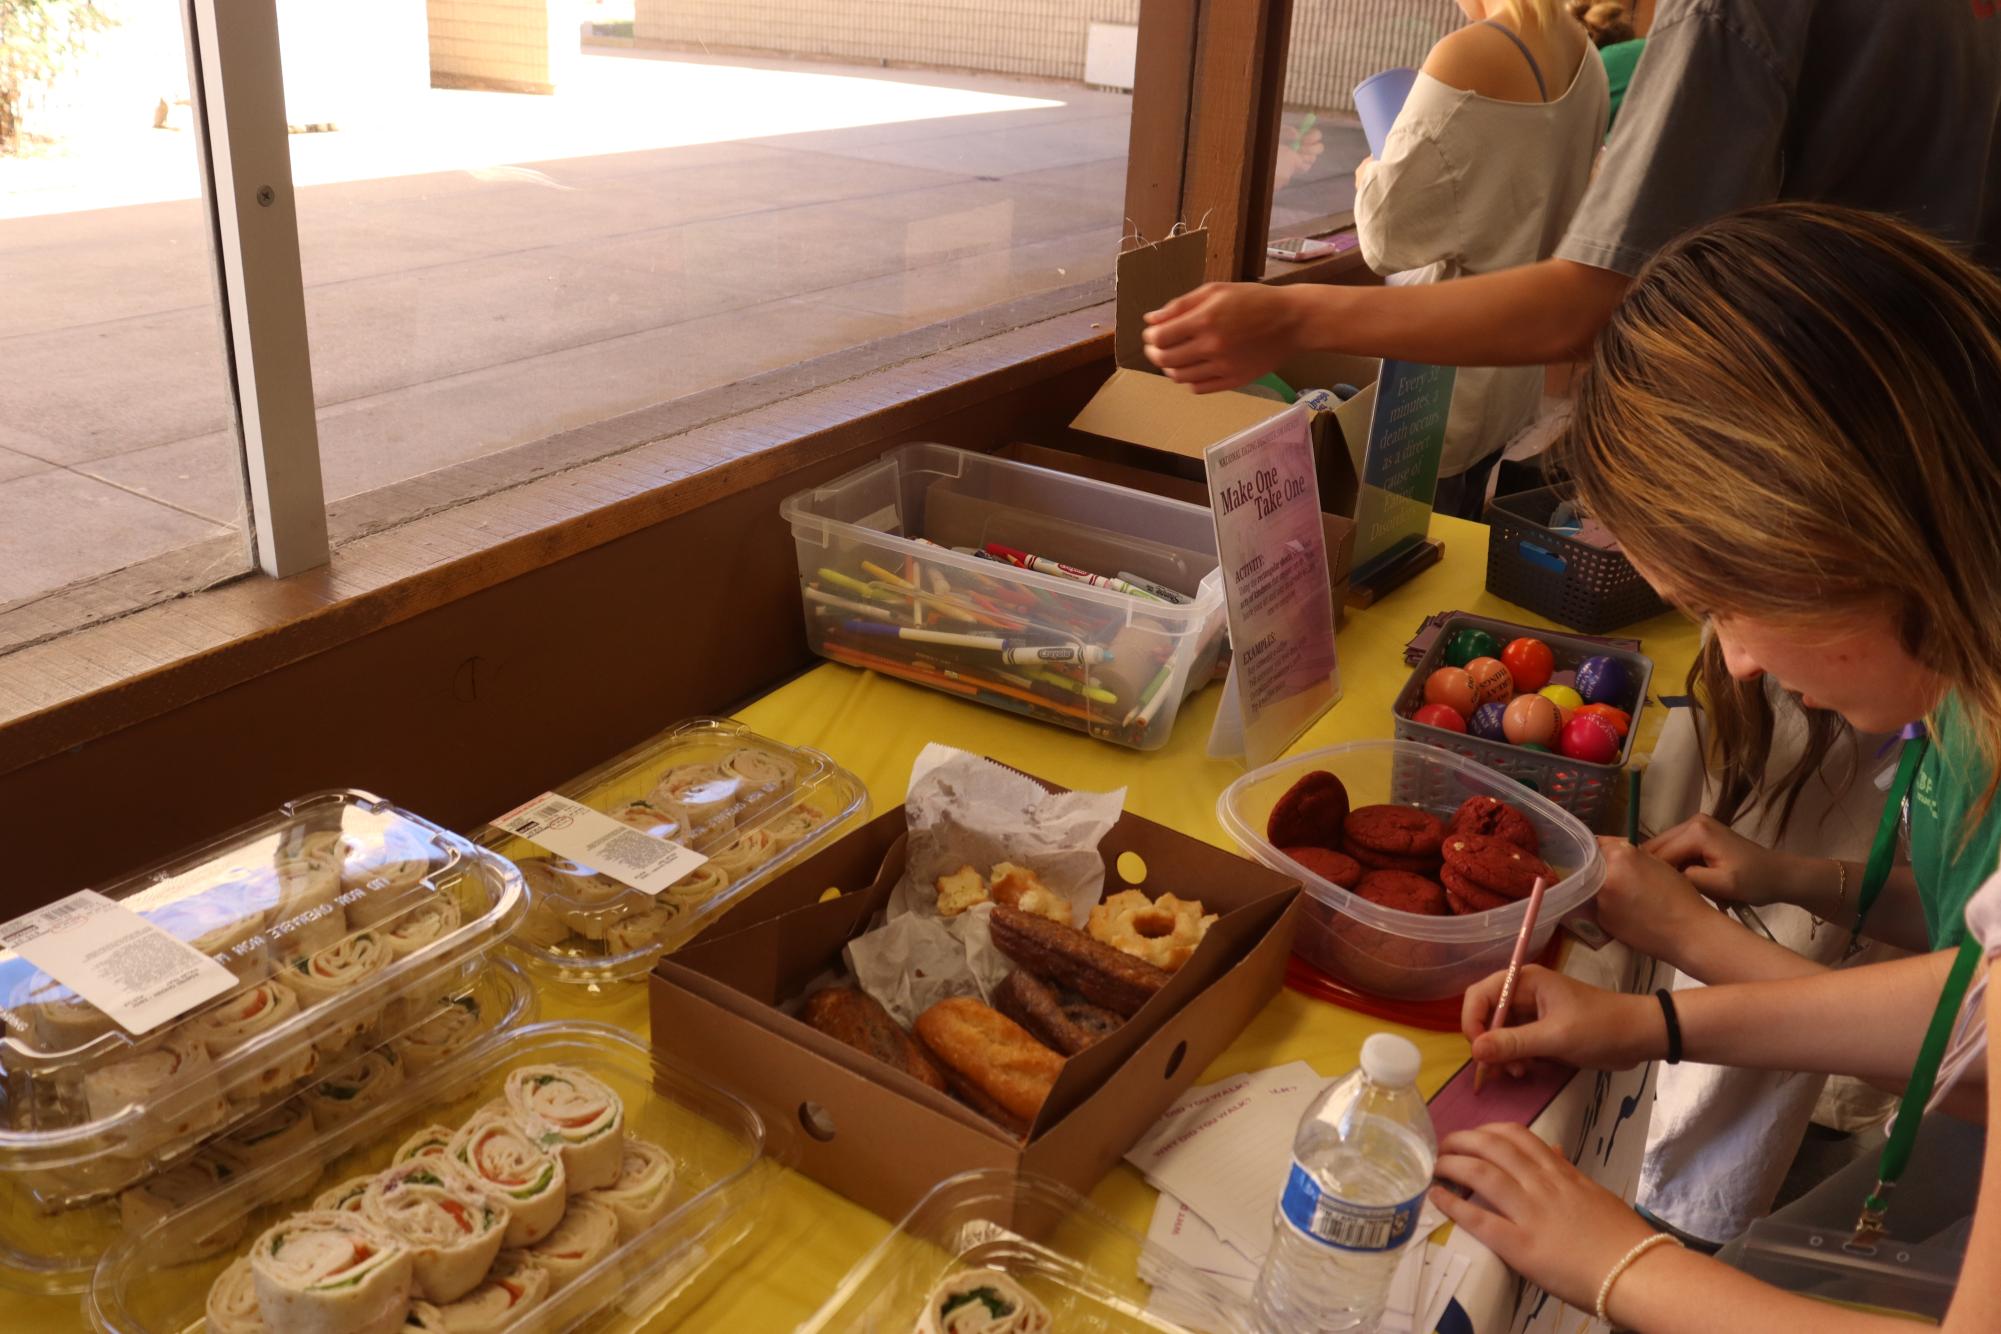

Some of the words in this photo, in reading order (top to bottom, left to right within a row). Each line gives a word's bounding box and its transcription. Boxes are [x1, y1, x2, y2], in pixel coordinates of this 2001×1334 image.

[1398, 375, 1426, 397] Every
[1379, 425, 1408, 450] death
[1220, 480, 1254, 516] Make
[1255, 467, 1278, 494] One
[1254, 486, 1282, 520] Take
[1284, 475, 1305, 502] One
[1235, 553, 1265, 584] ACTIVITY:
[1243, 631, 1277, 665] EXAMPLES:
